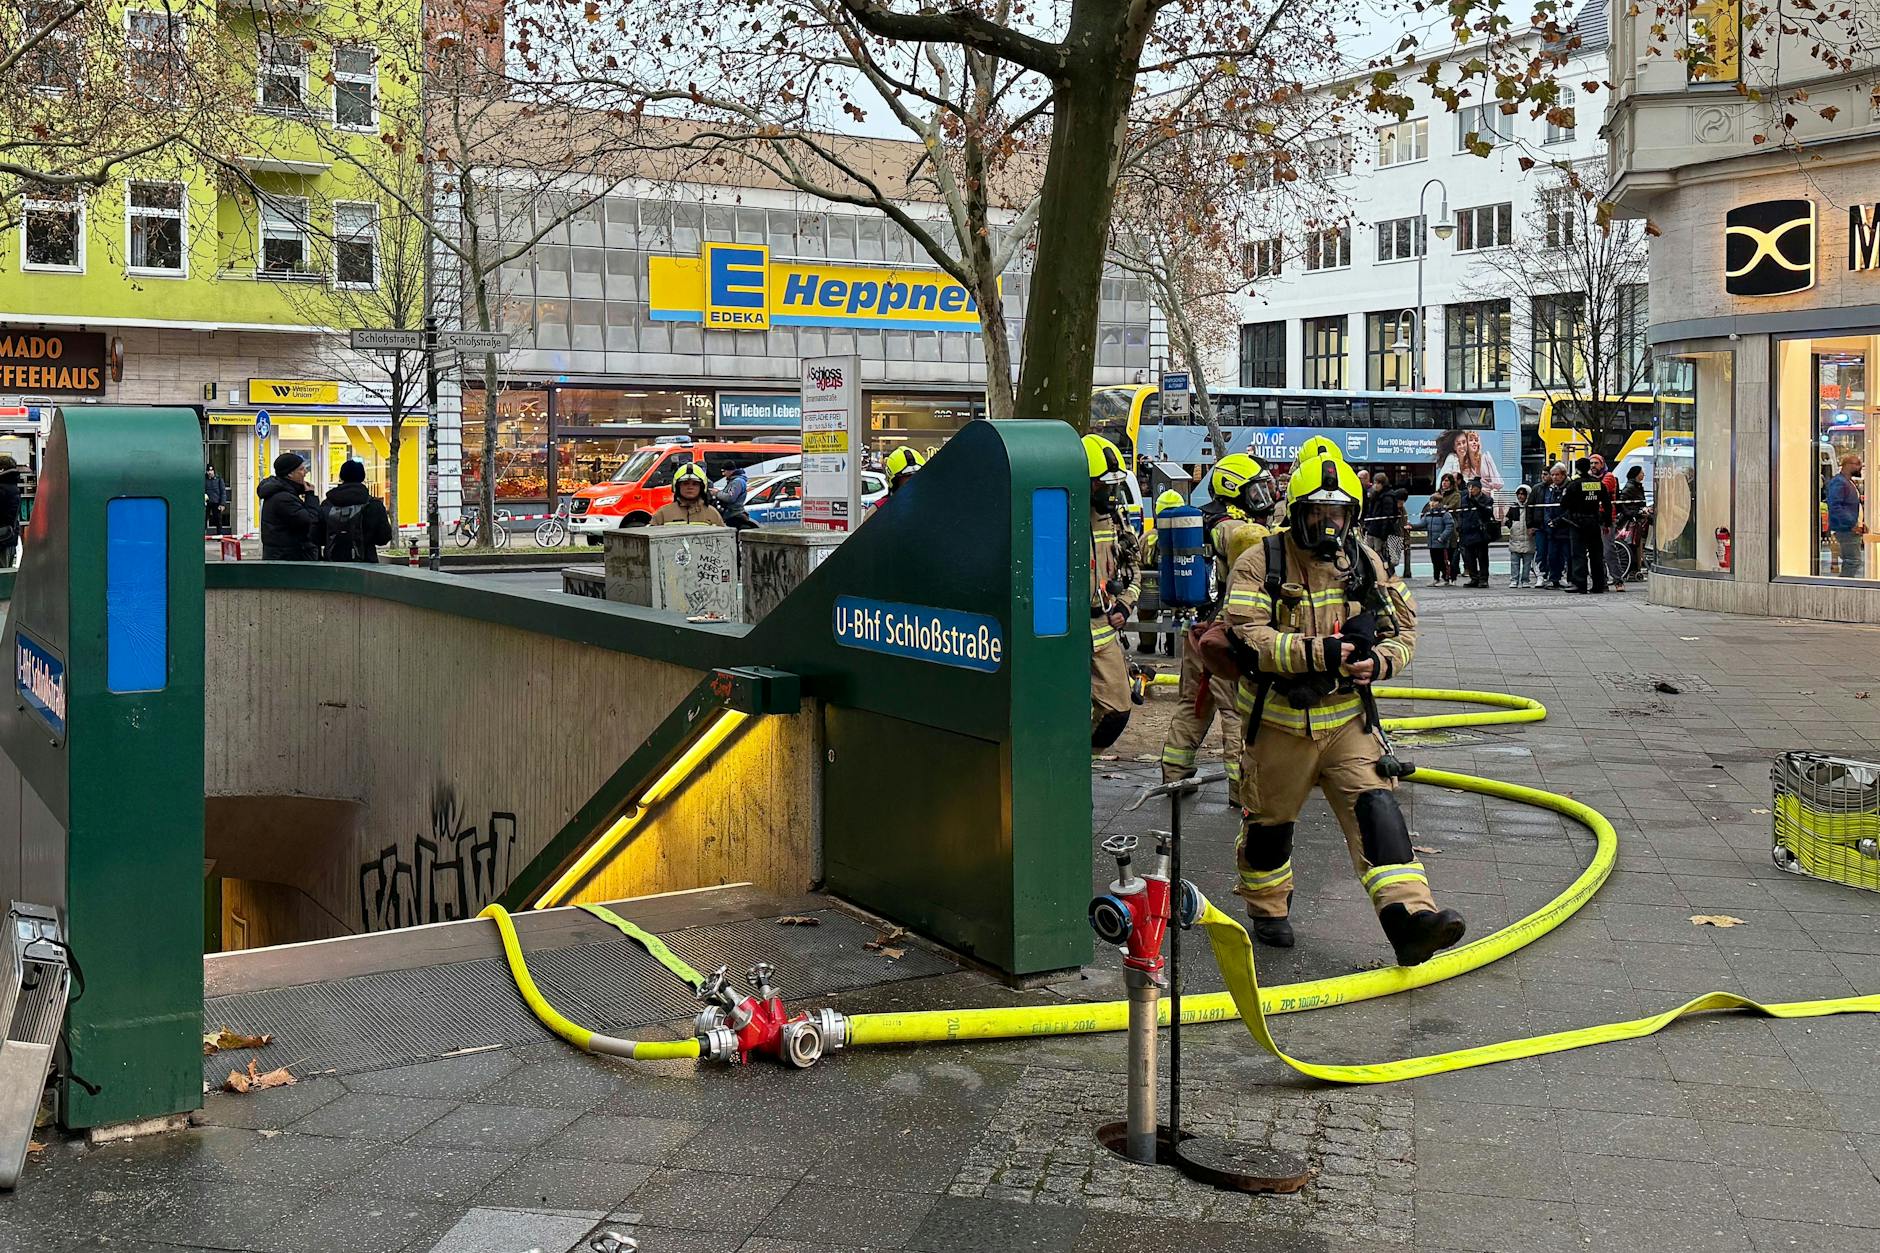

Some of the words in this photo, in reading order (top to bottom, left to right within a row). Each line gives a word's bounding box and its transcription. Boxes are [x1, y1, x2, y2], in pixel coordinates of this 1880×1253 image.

[711, 312, 764, 324] EDEKA
[358, 332, 417, 344] Schloßstraße
[449, 335, 502, 347] Schloßstraße
[0, 336, 63, 359] MADO
[0, 365, 100, 390] FEEHAUS
[810, 366, 842, 381] Schloss
[722, 403, 739, 416] Wir
[741, 404, 770, 417] lieben
[773, 405, 800, 418] Leben
[1251, 432, 1269, 445] JOY
[1271, 432, 1284, 445] OF
[836, 606, 881, 642] U-Bhf
[885, 613, 1001, 663] Schloßstraße
[1198, 1007, 1226, 1021] 14811
[1280, 998, 1295, 1010] ZPC
[1072, 1019, 1096, 1032] 2016
